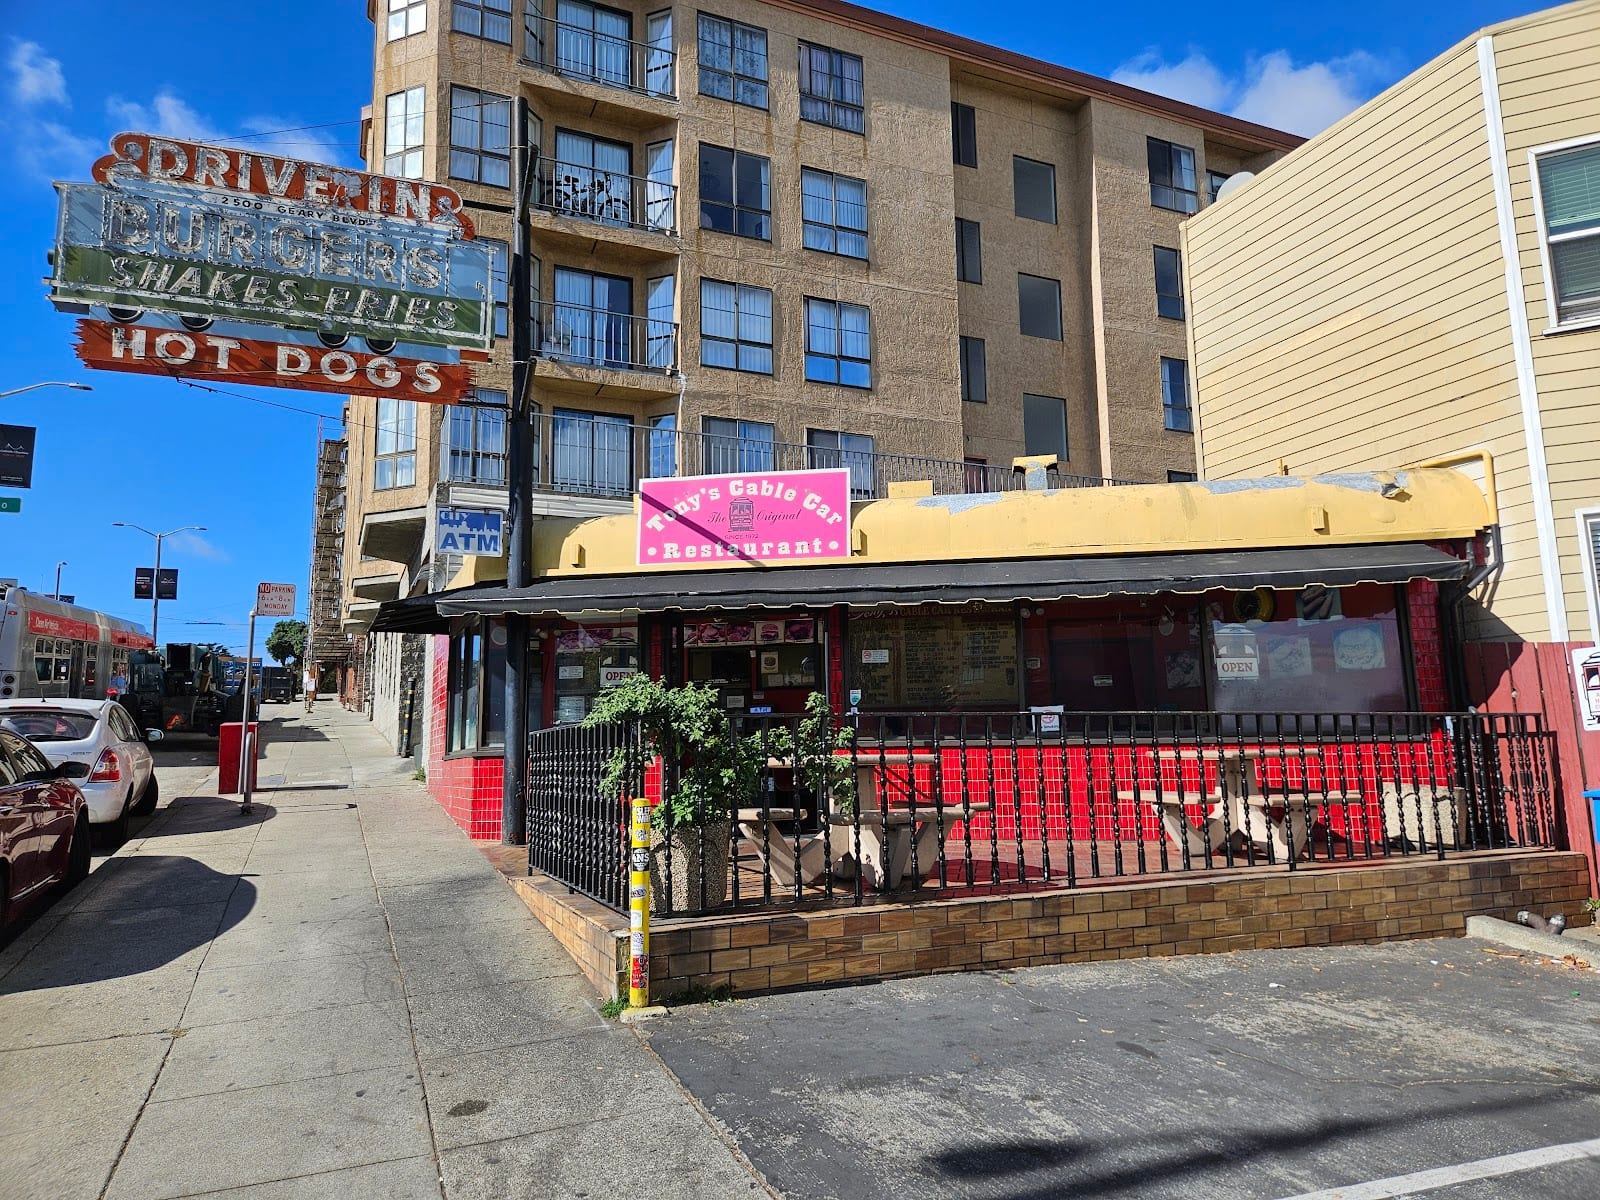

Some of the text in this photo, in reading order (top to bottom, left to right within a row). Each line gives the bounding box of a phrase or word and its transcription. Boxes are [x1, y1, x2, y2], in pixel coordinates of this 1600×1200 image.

[222, 197, 263, 210] 2500
[278, 206, 324, 219] GEARY
[109, 200, 443, 289] BURGERS
[111, 327, 442, 393] HOT DOGS
[646, 479, 843, 532] Tony's Cable Car
[707, 509, 802, 524] The Original
[440, 532, 499, 551] ATM
[663, 537, 823, 559] Restaurant
[260, 583, 295, 593] NO PARKING
[605, 671, 635, 681] OPEN
[1222, 662, 1253, 672] OPEN
